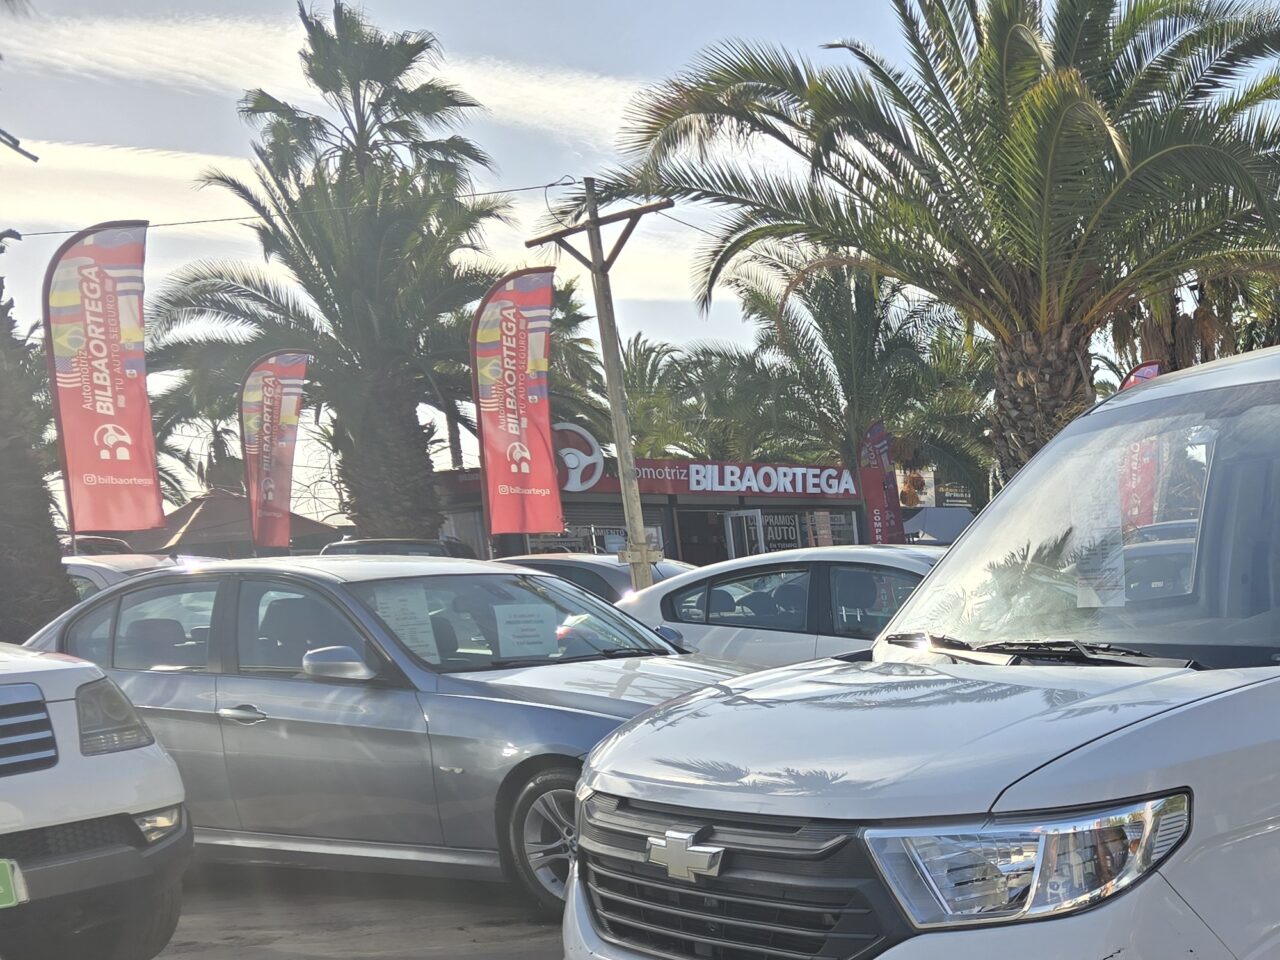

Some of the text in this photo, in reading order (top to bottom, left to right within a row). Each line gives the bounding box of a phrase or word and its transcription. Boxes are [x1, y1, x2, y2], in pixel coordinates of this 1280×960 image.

[80, 266, 115, 416] BILBAORTEGA
[105, 294, 124, 391] TU AUTO SEGURO
[501, 308, 520, 435] BILBAORTEGA
[77, 350, 94, 410] Automotriz
[518, 373, 526, 400] AUTO
[263, 377, 276, 471] BILBAORTEGA
[606, 464, 857, 495] omotriz BILBAORTEGA
[767, 526, 796, 541] AUTO
